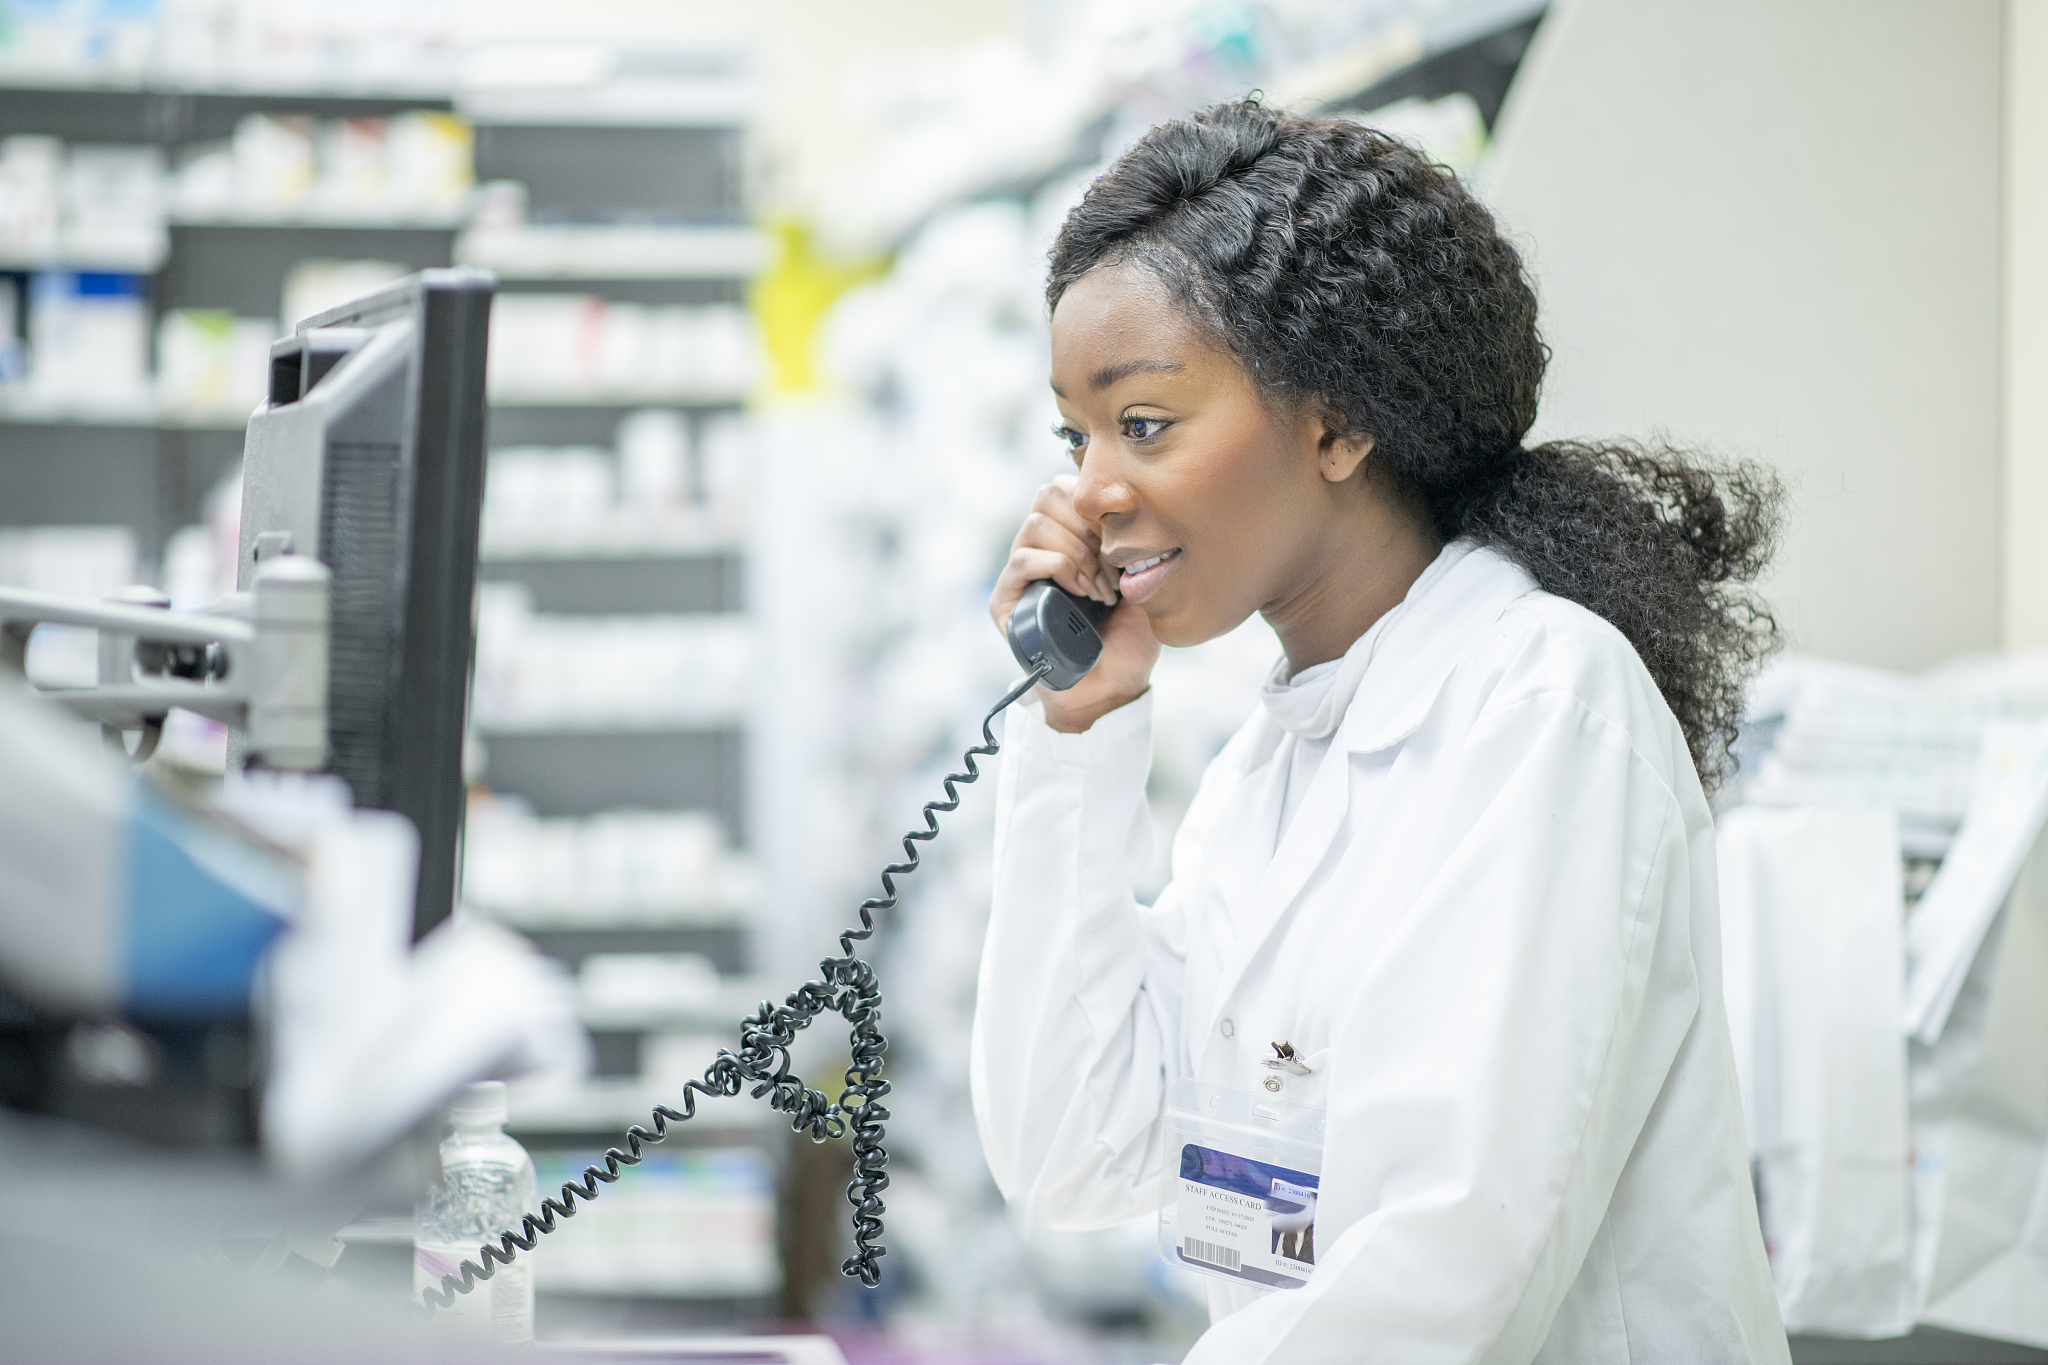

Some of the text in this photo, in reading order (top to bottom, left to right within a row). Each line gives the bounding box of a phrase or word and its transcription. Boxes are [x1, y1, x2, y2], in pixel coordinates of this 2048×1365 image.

[1185, 1184, 1262, 1211] STAFF ACCESS CARD
[1205, 1224, 1238, 1238] FULL ACCESS
